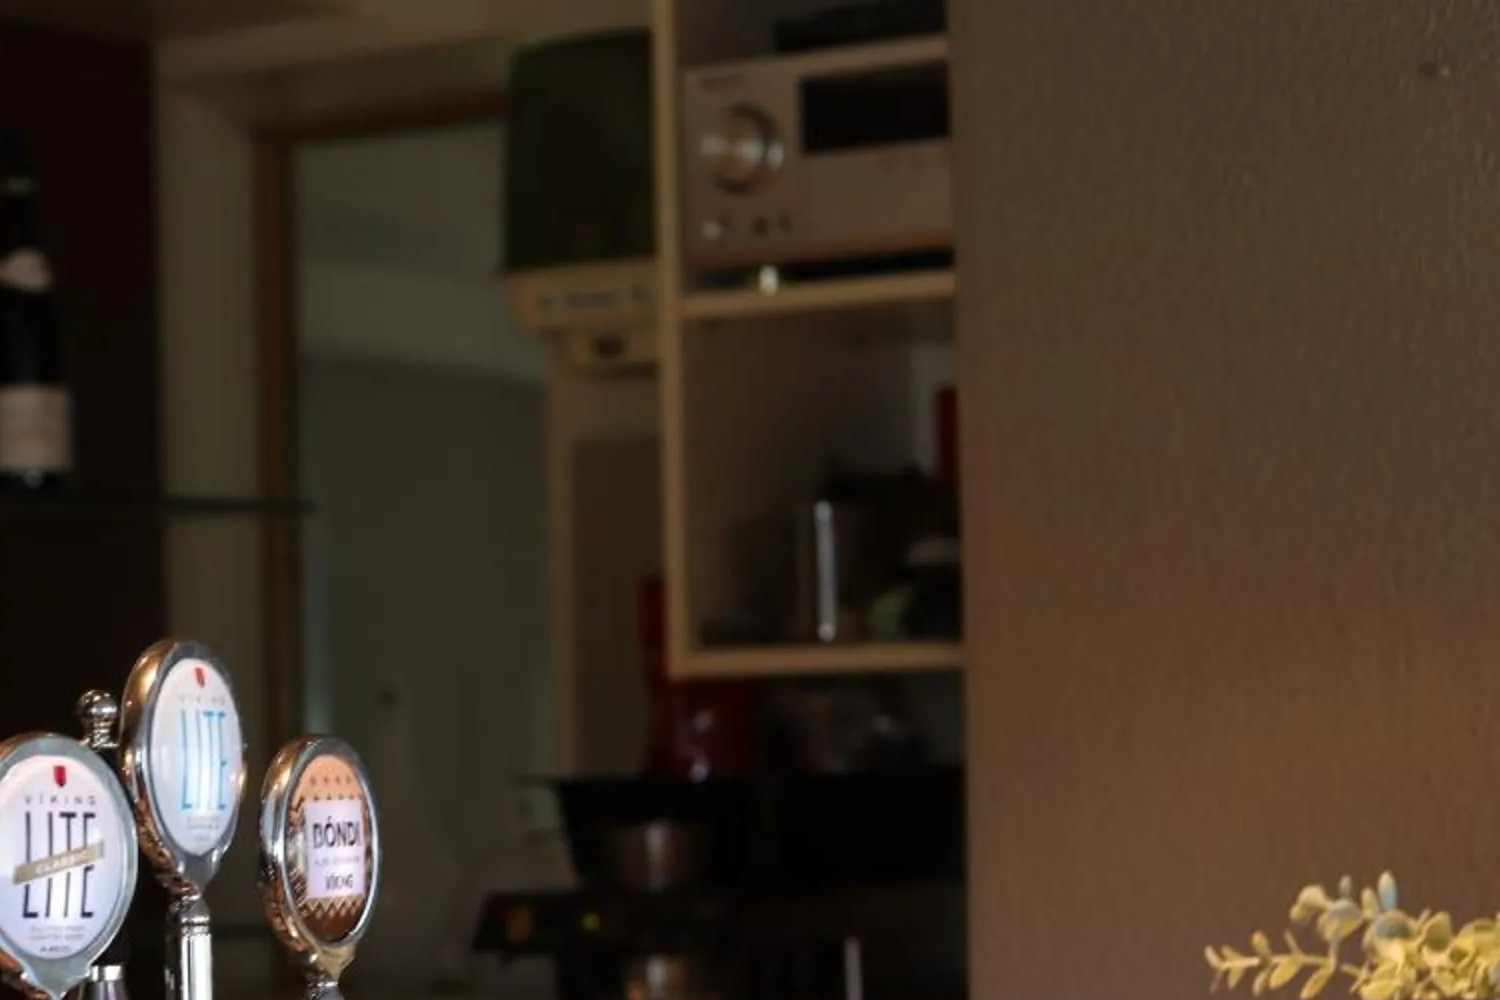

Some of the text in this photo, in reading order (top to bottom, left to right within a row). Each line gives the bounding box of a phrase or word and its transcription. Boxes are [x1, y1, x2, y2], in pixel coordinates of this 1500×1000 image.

[180, 709, 227, 810] LITE
[22, 811, 96, 918] LITE
[313, 815, 361, 849] BÓNDI
